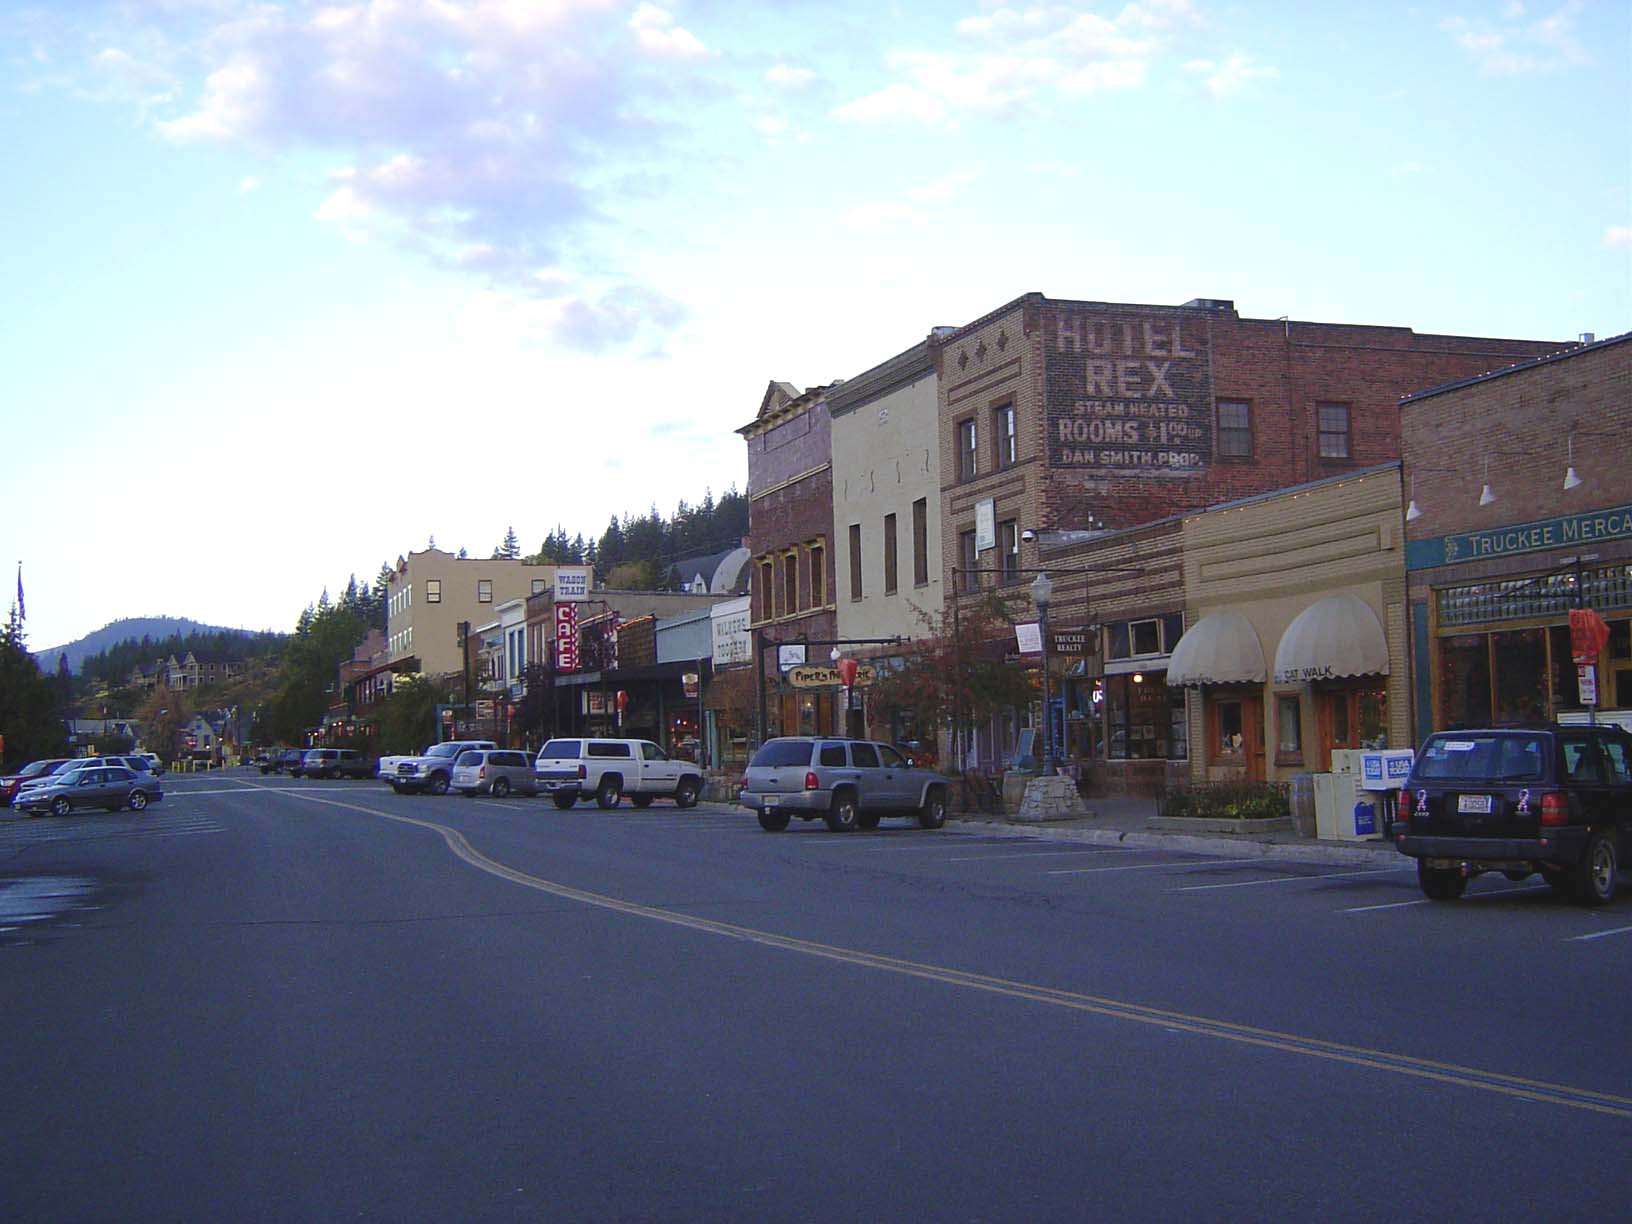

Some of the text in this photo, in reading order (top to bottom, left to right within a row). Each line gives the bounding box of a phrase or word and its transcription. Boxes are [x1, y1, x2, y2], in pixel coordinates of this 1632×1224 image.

[1056, 317, 1196, 358] HOTEL
[1086, 359, 1176, 399] REX
[1129, 403, 1188, 418] HEATED
[1059, 418, 1139, 443] ROOMS
[1062, 450, 1095, 465] DAN
[1469, 527, 1553, 555] TRUCKEE
[559, 575, 586, 584] WAGON
[560, 587, 585, 595] TRAIN
[558, 607, 572, 667] CAFE
[1055, 635, 1085, 643] TRUCKEE
[1057, 644, 1081, 652] REALTY
[1284, 670, 1299, 680] CAT
[1302, 665, 1332, 679] WALK
